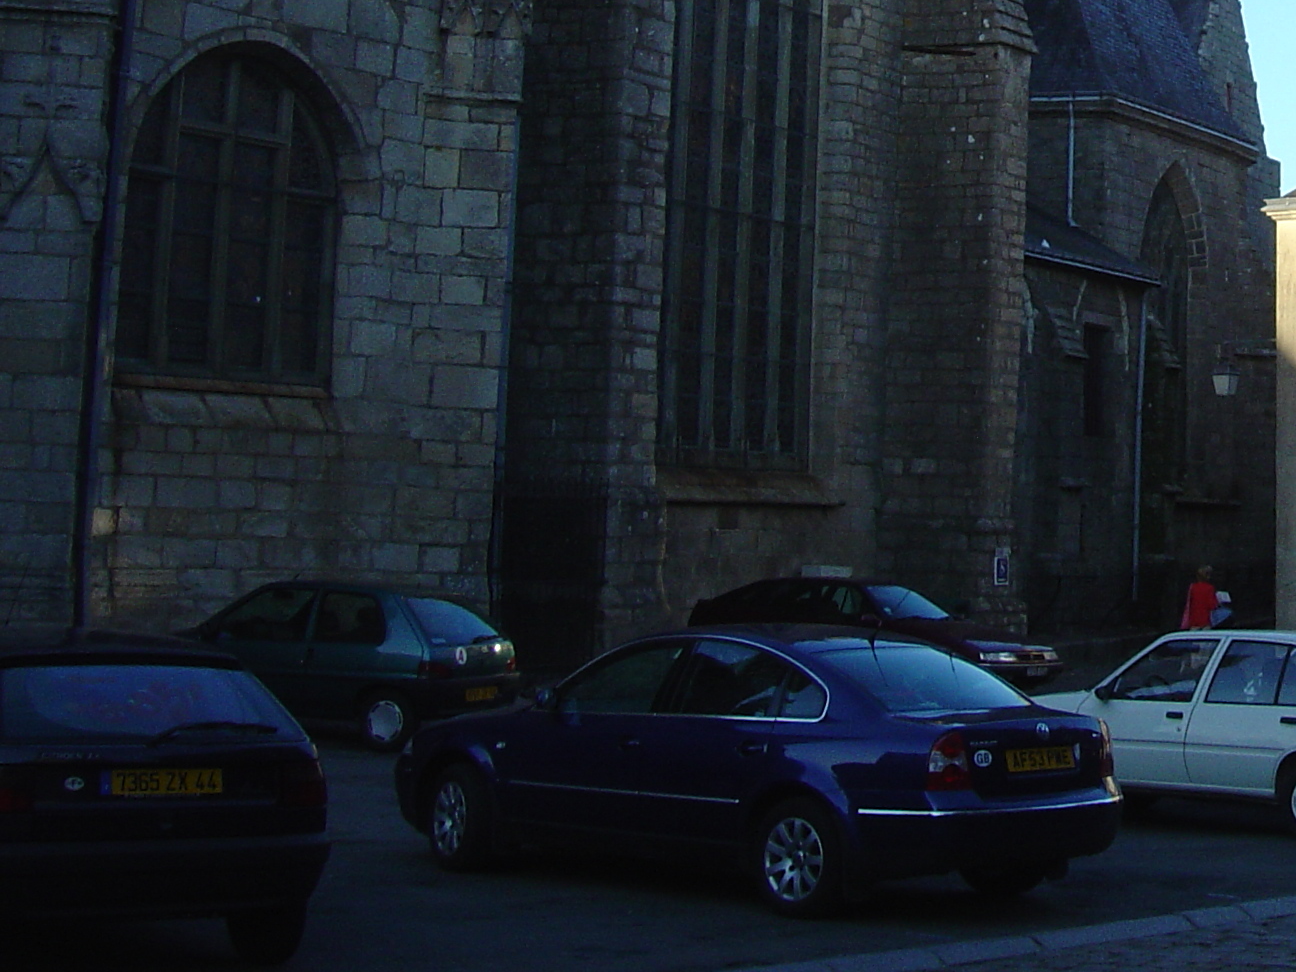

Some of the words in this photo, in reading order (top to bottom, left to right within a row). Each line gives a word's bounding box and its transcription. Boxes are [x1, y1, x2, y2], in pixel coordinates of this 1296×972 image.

[976, 753, 990, 764] GB
[116, 772, 160, 792] 7365
[166, 772, 188, 791] ZX
[195, 772, 217, 791] 44
